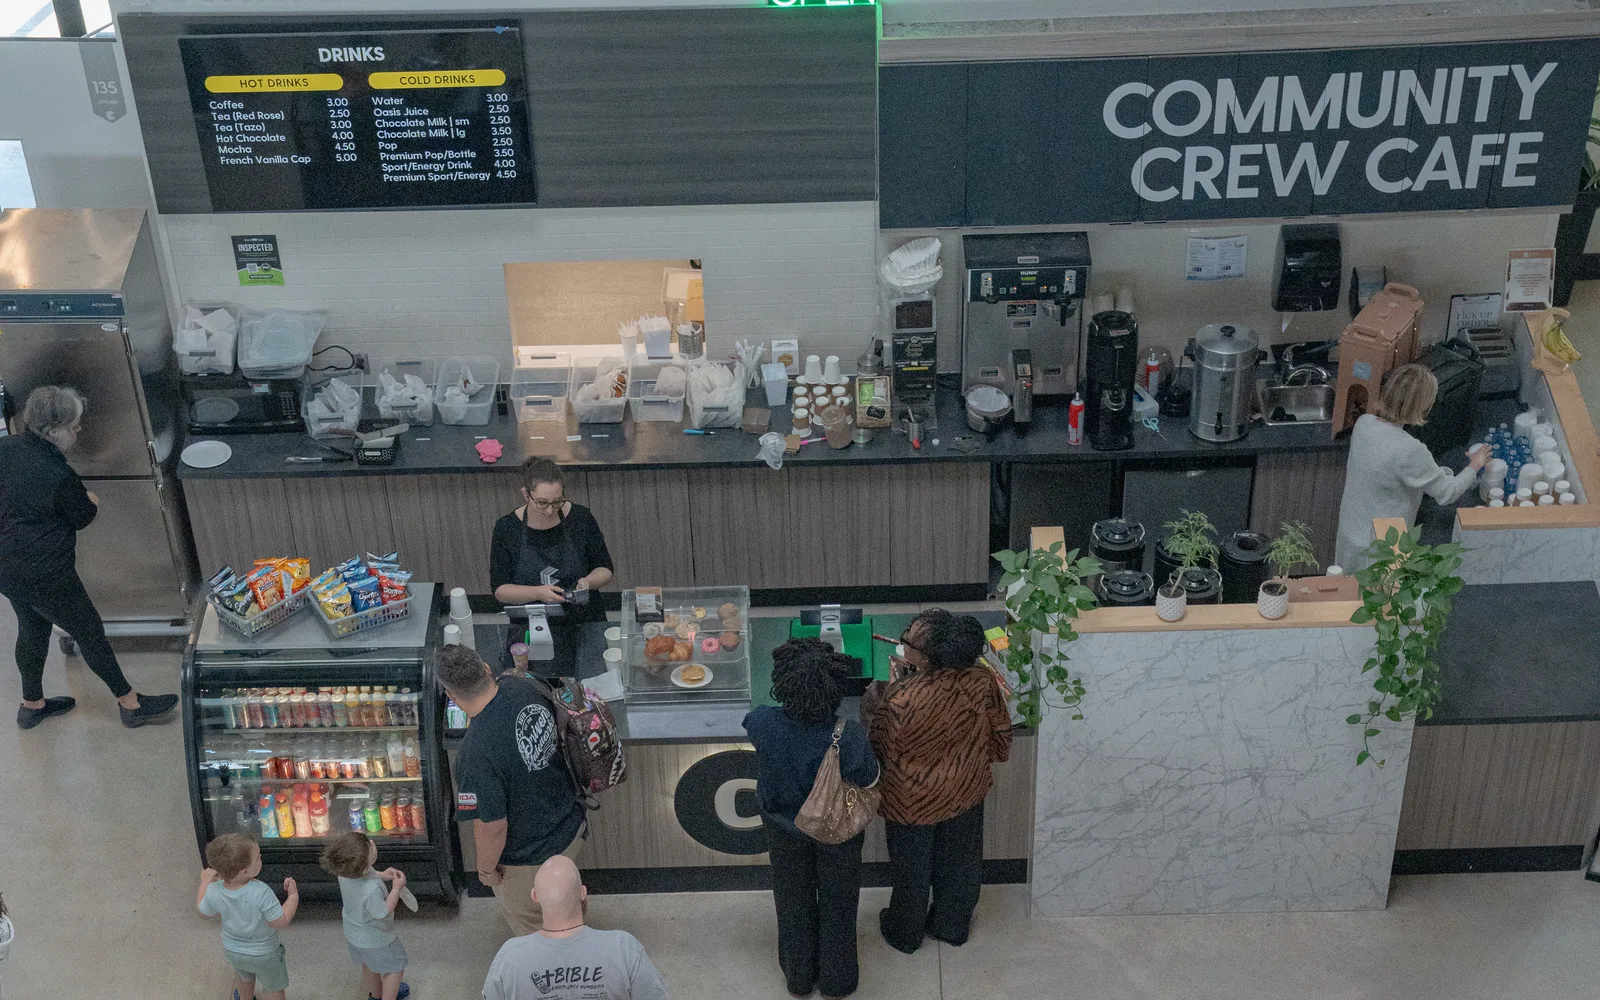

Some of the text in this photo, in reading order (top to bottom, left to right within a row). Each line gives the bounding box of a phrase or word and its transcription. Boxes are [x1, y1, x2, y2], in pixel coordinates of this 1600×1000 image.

[318, 46, 385, 62] DRINKS
[240, 78, 309, 88] HOT DRINKS
[399, 75, 476, 85] COLD DRINKS
[92, 81, 118, 94] 135
[209, 98, 348, 110] Coffee 3.00
[371, 93, 508, 106] Water 3.00
[1102, 62, 1559, 139] COMMUNITY
[211, 109, 350, 121] Tea (Red Rose) 2.50
[373, 104, 509, 117] Oasis Juice 2.50
[213, 120, 352, 132] Tea (Tazo) 3.00
[375, 118, 425, 128] Chocolate
[427, 117, 448, 127] Milk
[454, 118, 470, 126] sm
[490, 115, 511, 125] 2.50
[215, 131, 354, 143] Hot Chocolate 4.00
[376, 129, 427, 139] Chocolate
[428, 128, 449, 138] Milk
[456, 128, 466, 138] lg
[491, 126, 512, 136] 3.50
[217, 142, 356, 154] Mocha 4.50
[378, 137, 513, 151] Pop 2.50
[220, 153, 358, 165] French Vanilla Cap 5.00
[380, 148, 514, 161] Premium Pop/Bottle 3.50
[381, 159, 516, 173] Sport/Energy Drink 4.00
[1131, 131, 1544, 203] CREW CAFE
[383, 170, 517, 183] Premium Sport/Energy 4.50
[237, 243, 274, 252] INSPECTED
[1456, 311, 1492, 320] PICK UP
[1456, 319, 1489, 328] ORDER
[554, 966, 604, 984] BIBLE
